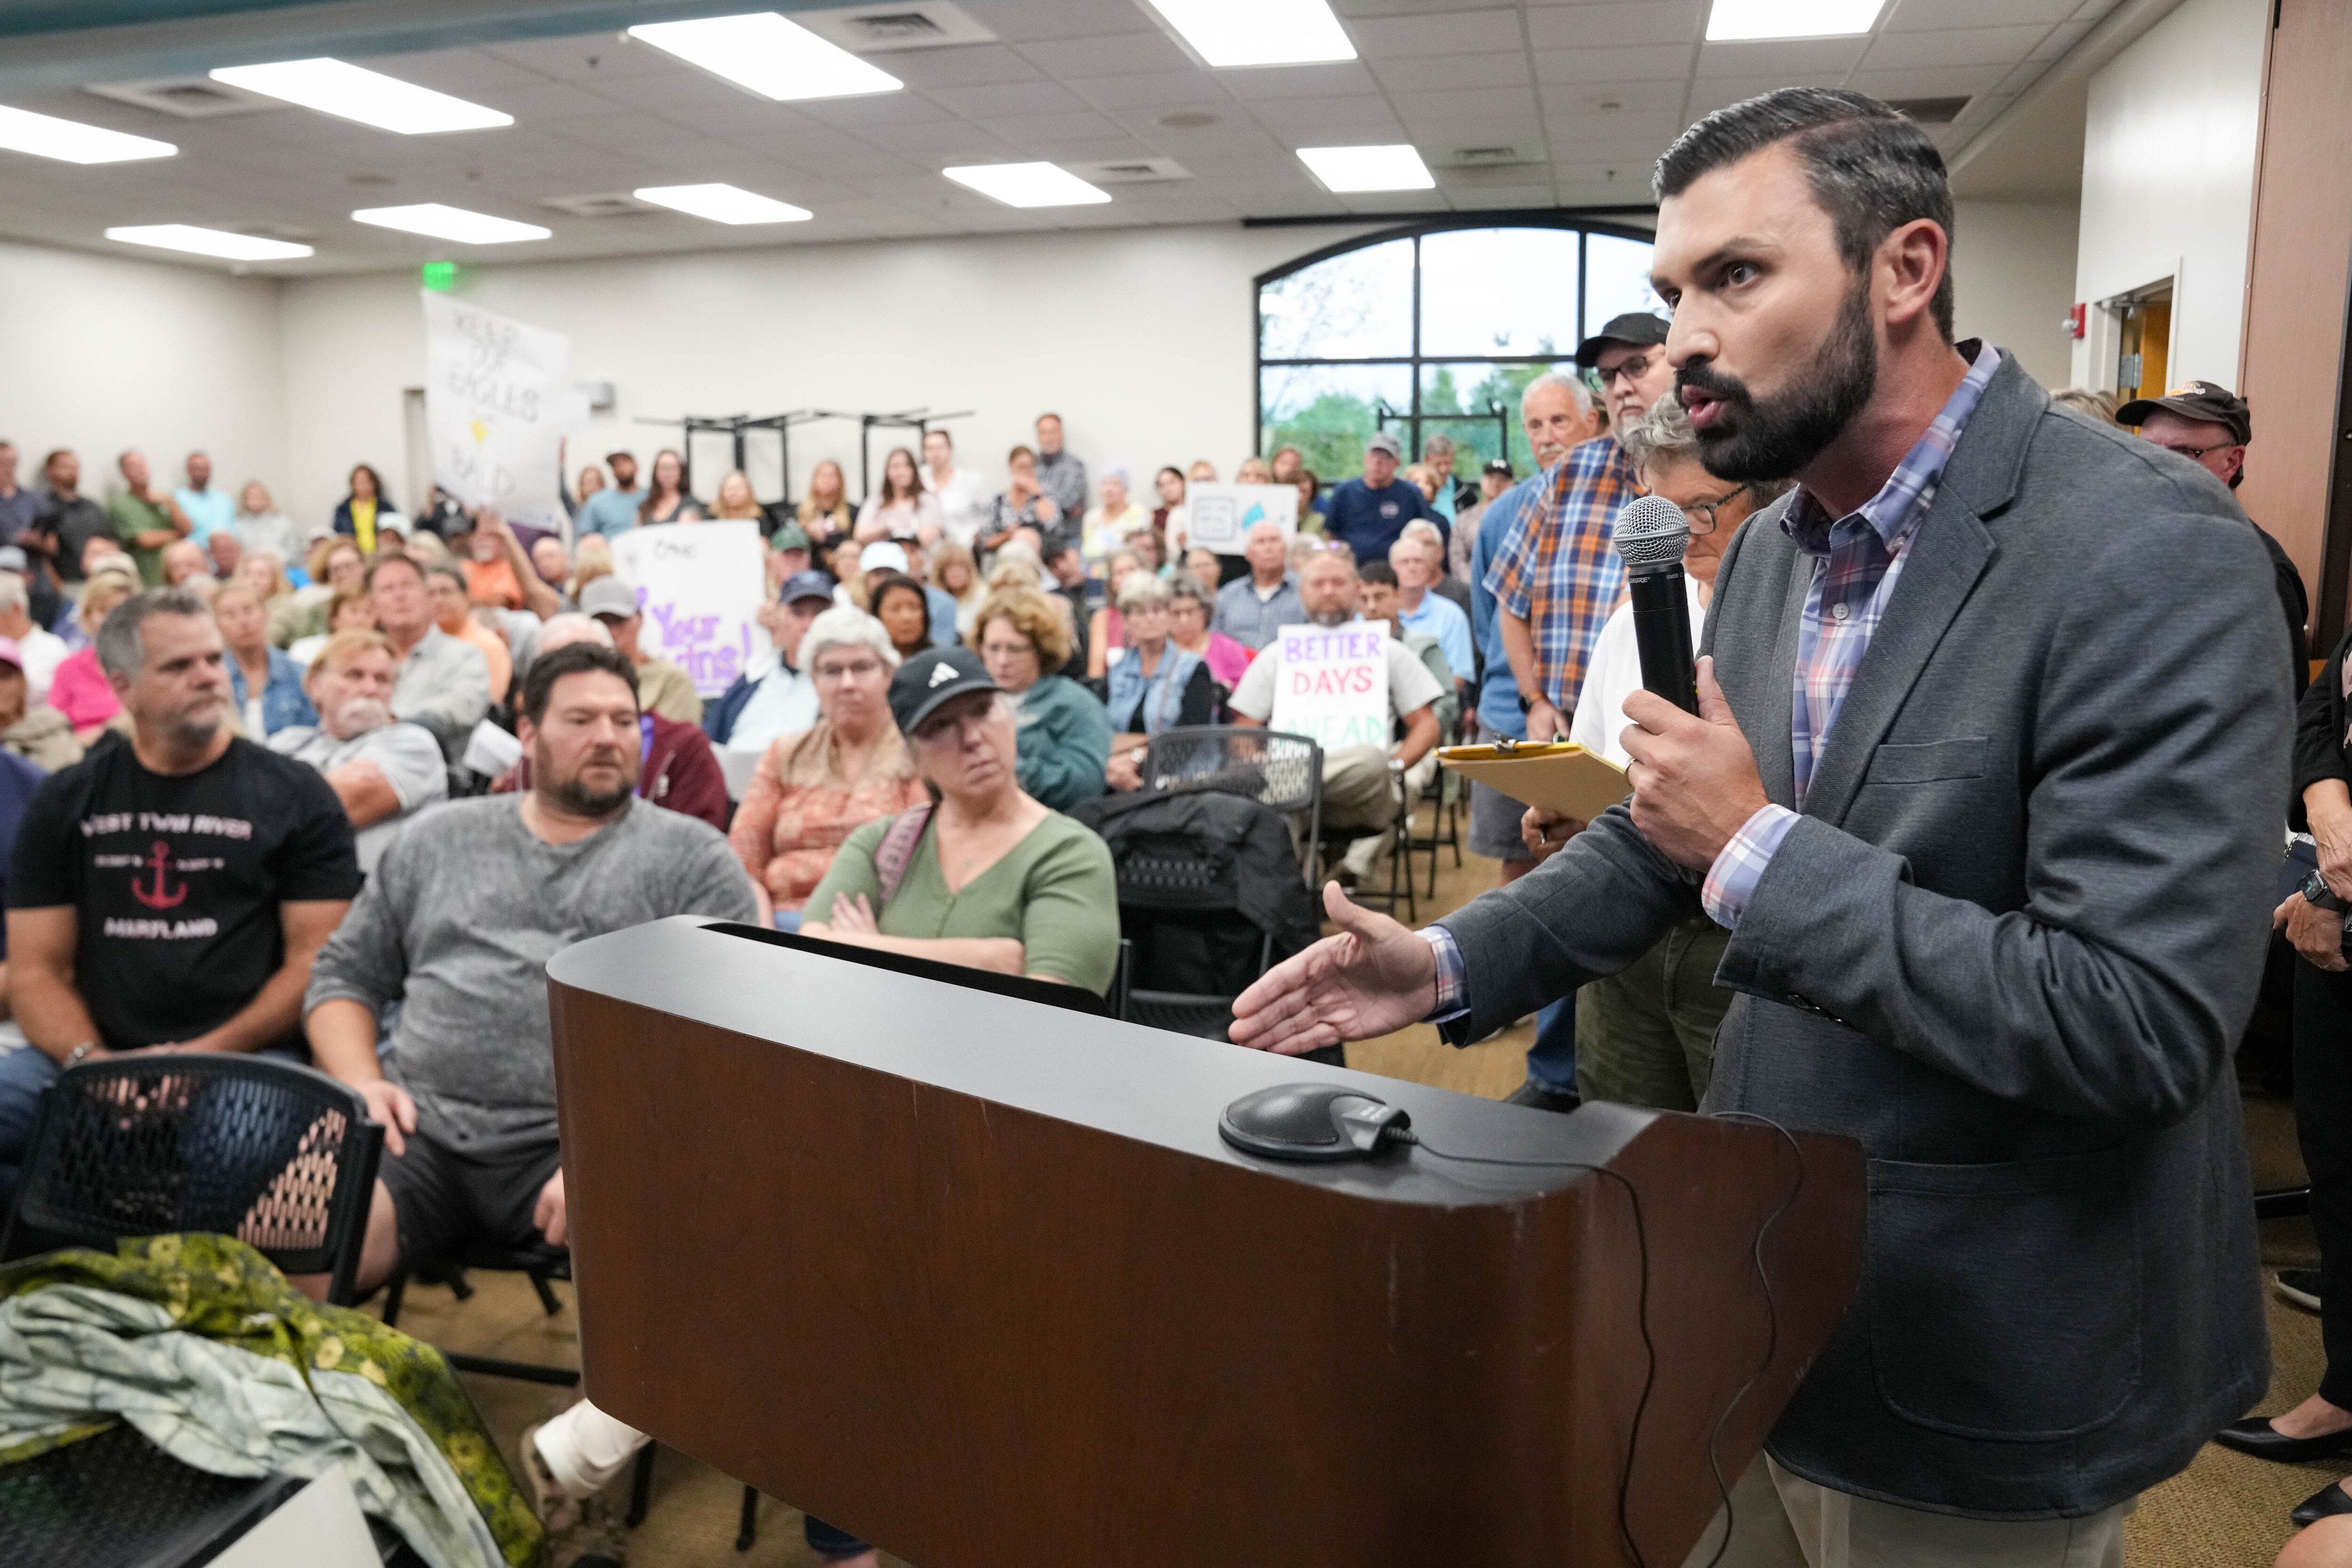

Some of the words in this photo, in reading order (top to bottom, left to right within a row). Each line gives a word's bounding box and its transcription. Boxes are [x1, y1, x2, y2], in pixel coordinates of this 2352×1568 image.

[1284, 632, 1381, 664] BETTER
[1292, 665, 1374, 696] DAYS
[192, 815, 252, 840] RIVER
